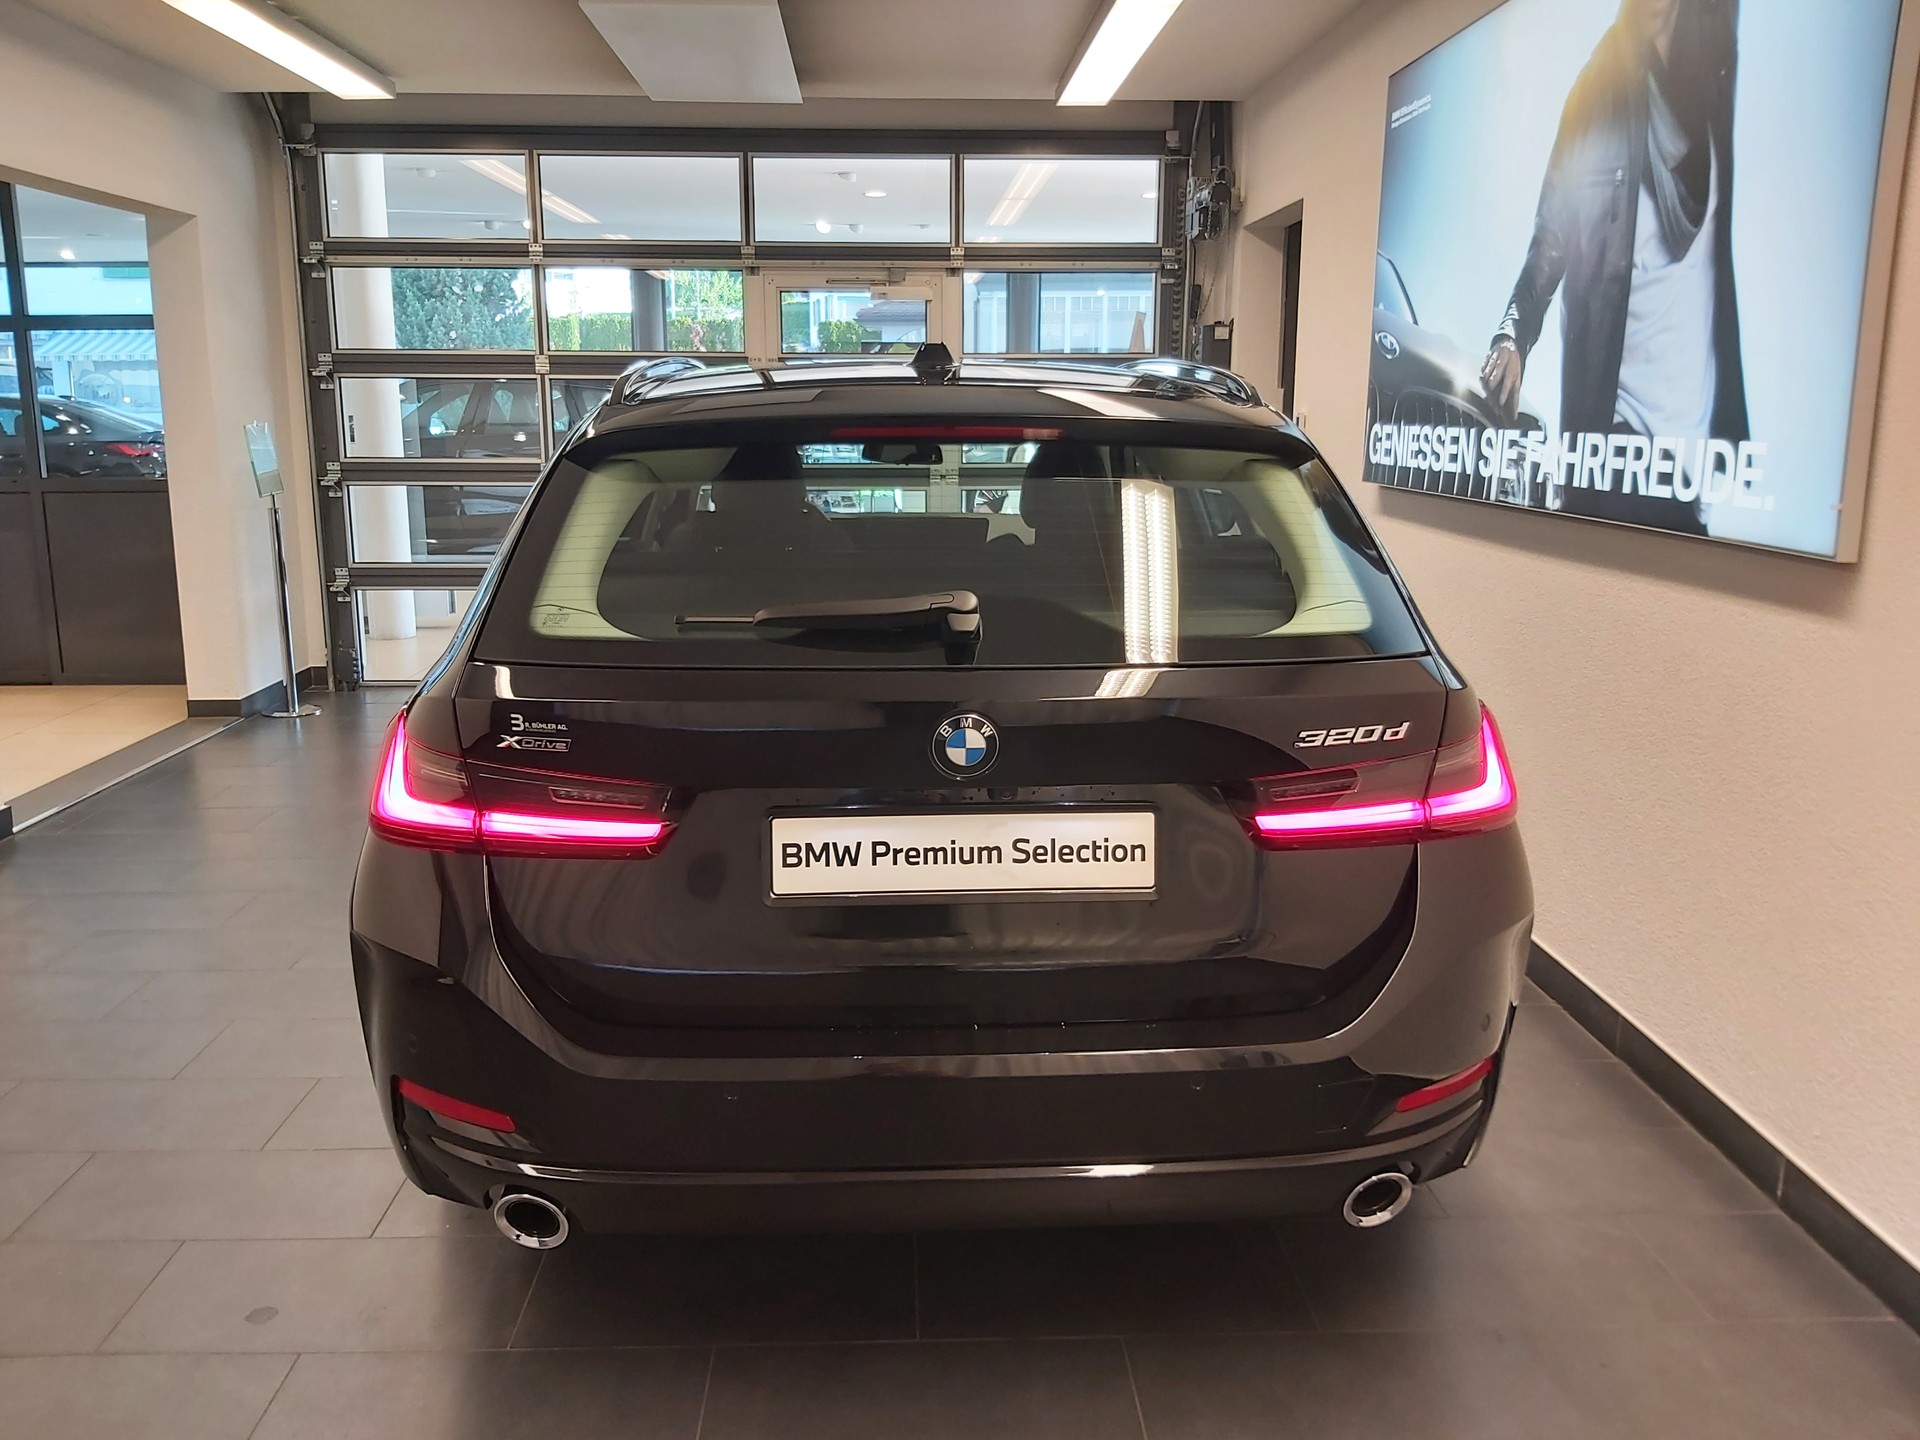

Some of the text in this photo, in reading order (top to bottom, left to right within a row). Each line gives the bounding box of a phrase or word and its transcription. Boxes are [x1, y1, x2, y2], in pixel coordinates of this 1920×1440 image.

[1368, 421, 1472, 476] GENIESSEN
[1478, 428, 1519, 479] SIE
[531, 721, 557, 730] BÜHLER
[940, 717, 994, 738] BMW
[1294, 721, 1410, 749] 320d
[781, 837, 1146, 868] BMW Premium Selection
